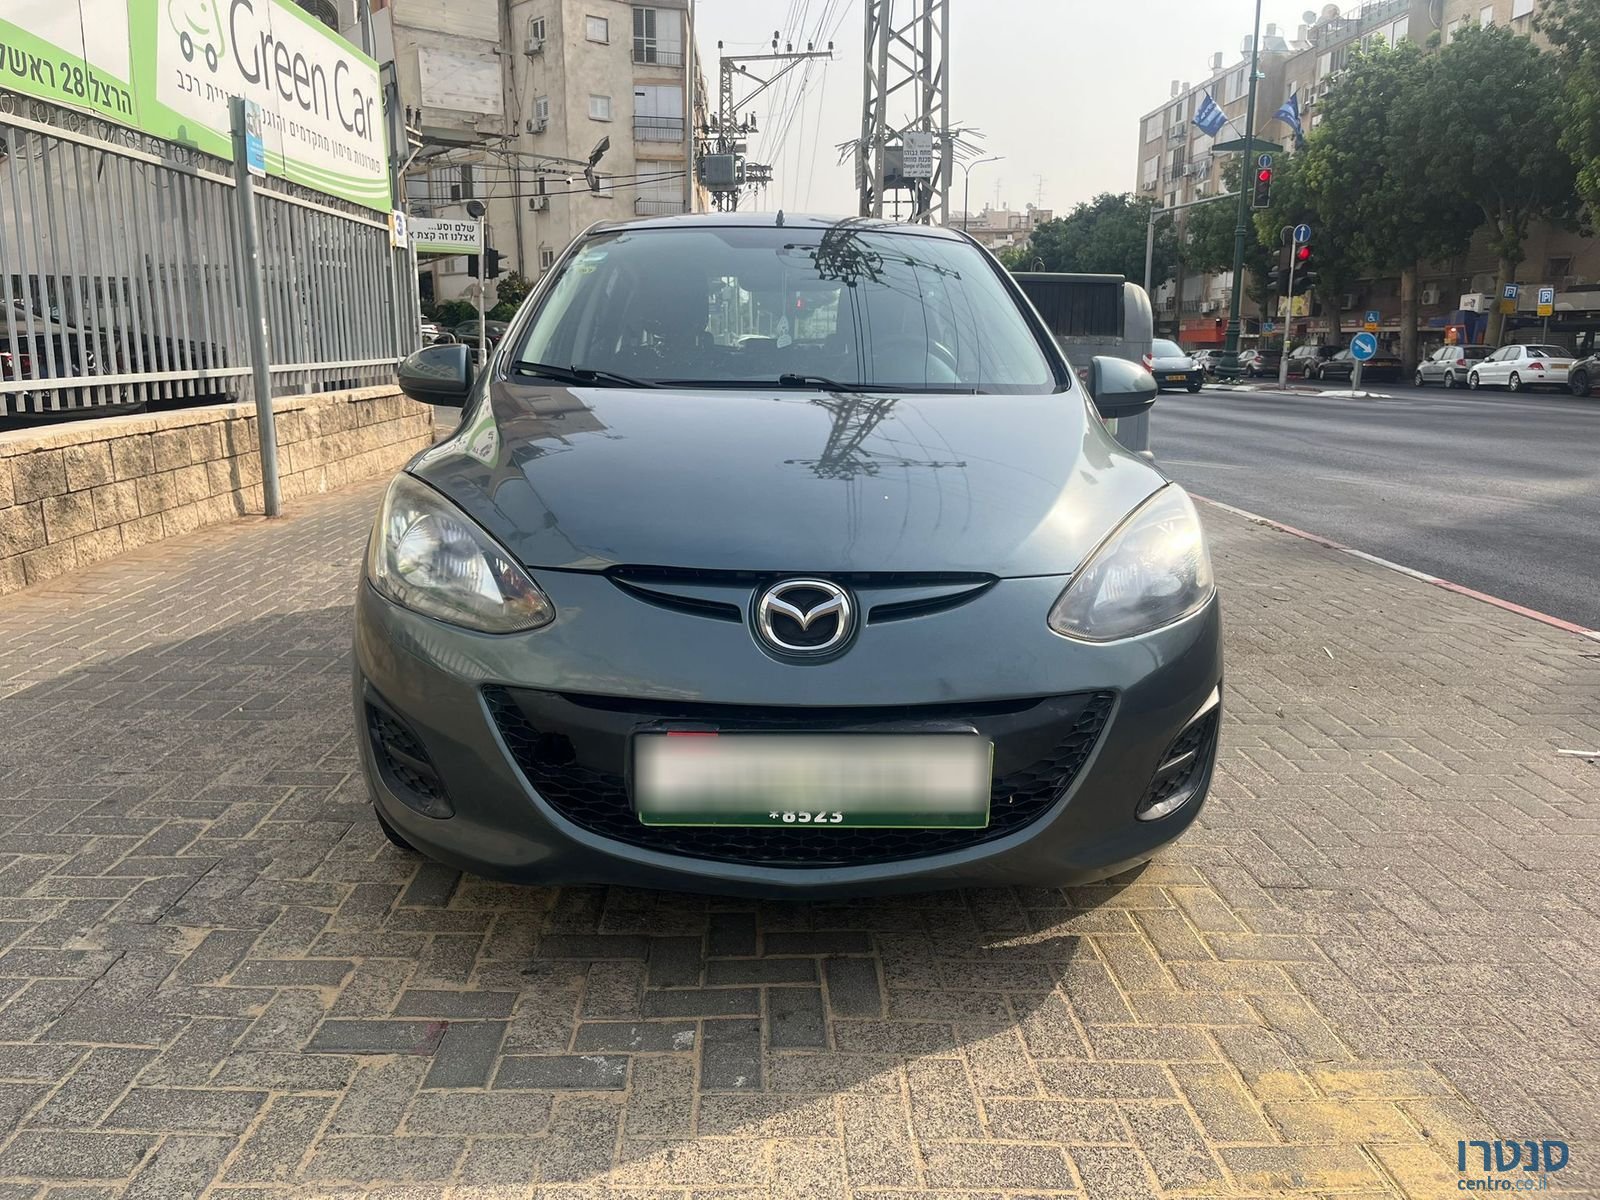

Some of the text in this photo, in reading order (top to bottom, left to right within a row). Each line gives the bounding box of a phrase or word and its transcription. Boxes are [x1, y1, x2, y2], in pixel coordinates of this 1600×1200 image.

[60, 62, 85, 98] 28
[176, 69, 201, 97] רכב
[229, 0, 374, 142] Green Car
[89, 71, 132, 115] הרצל
[289, 121, 329, 152] מתקדמים
[417, 231, 436, 241] קצת
[438, 232, 449, 241] זה
[451, 232, 475, 242] אצלנו
[454, 223, 475, 233] שלם
